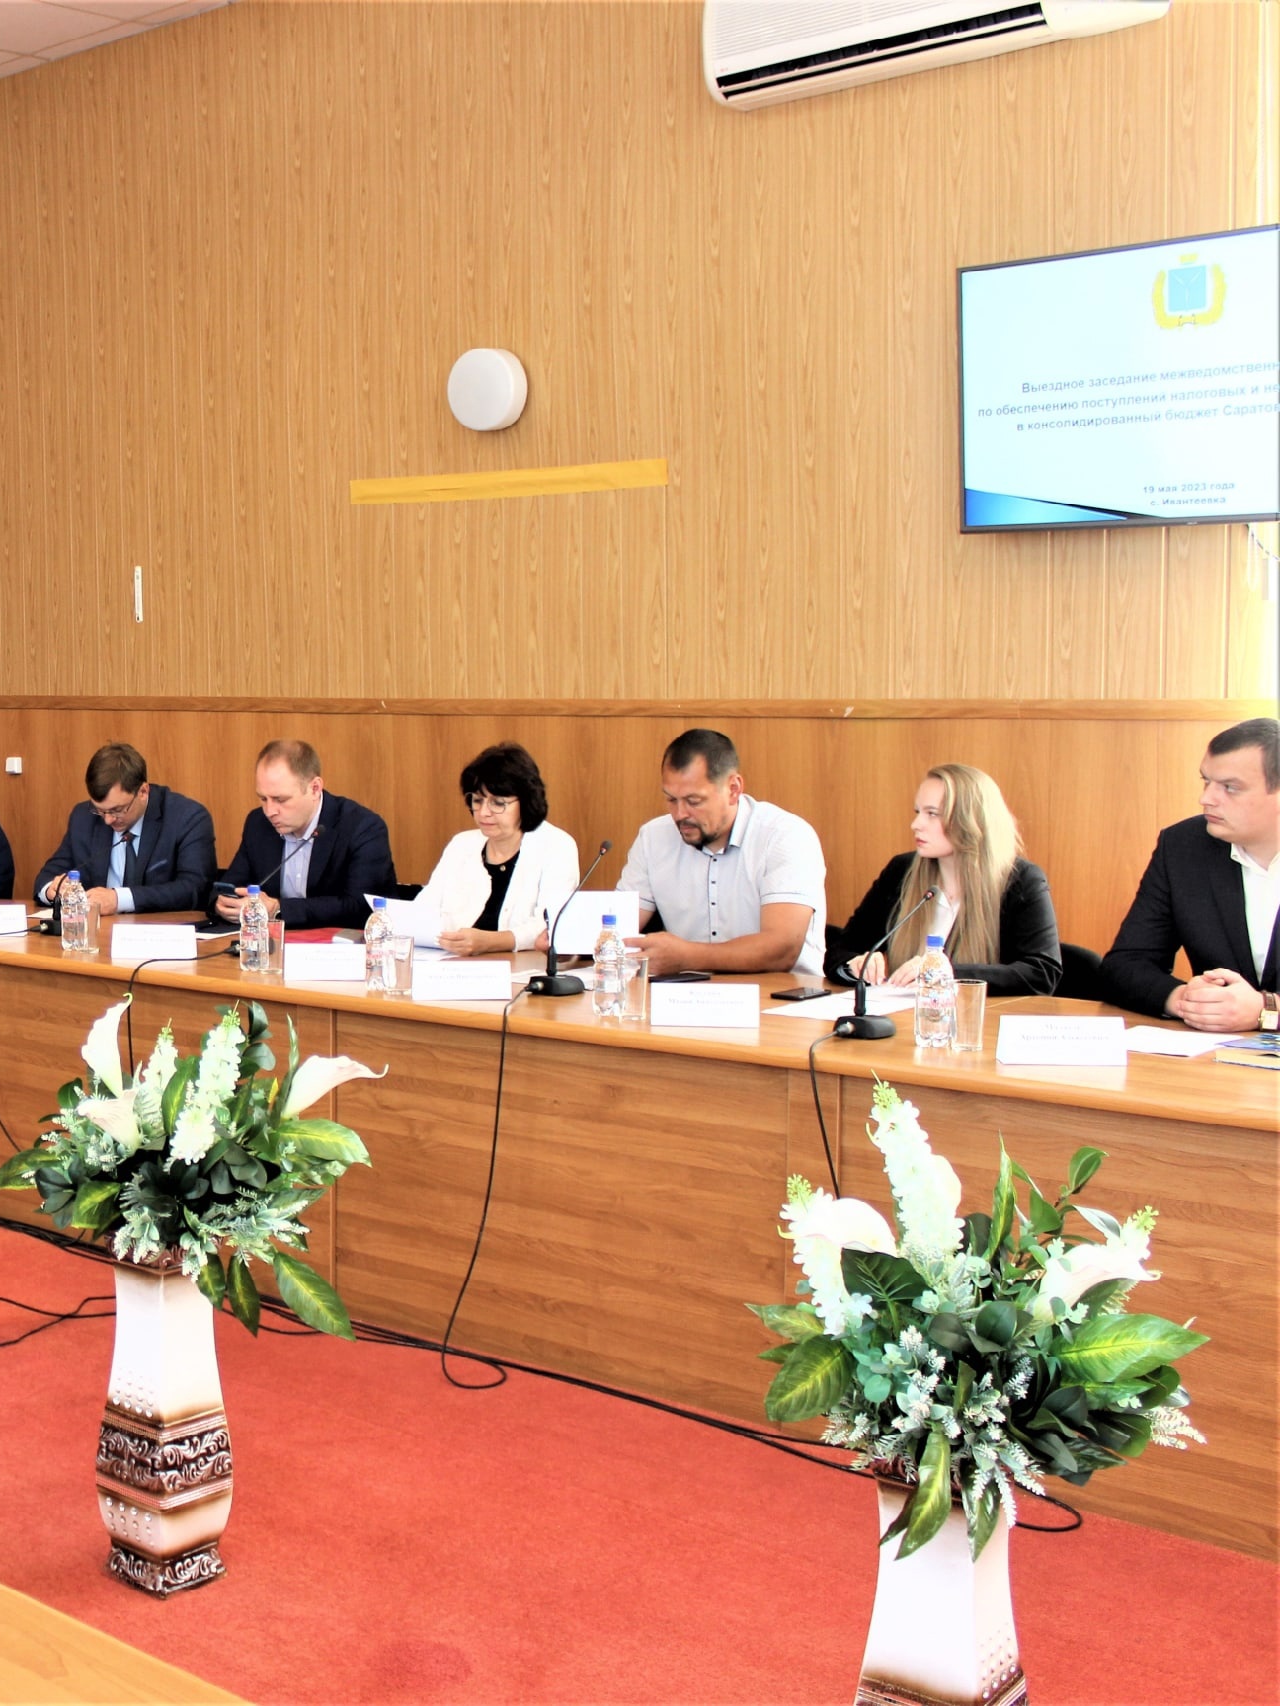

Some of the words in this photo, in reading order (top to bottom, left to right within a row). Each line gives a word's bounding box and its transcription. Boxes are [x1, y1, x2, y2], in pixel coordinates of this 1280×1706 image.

[1022, 378, 1085, 393] Выездное
[1088, 373, 1157, 388] заседание
[978, 407, 992, 417] по
[996, 399, 1078, 416] обеспечению
[1081, 392, 1166, 409] поступлений
[1170, 386, 1246, 402] налоговых
[1250, 385, 1259, 394] и
[1017, 423, 1024, 431] в
[1027, 412, 1161, 431] консолидированный
[1165, 408, 1218, 421] бюджет
[1143, 485, 1155, 494] 19
[1158, 485, 1178, 493] мая
[1210, 482, 1235, 491] года
